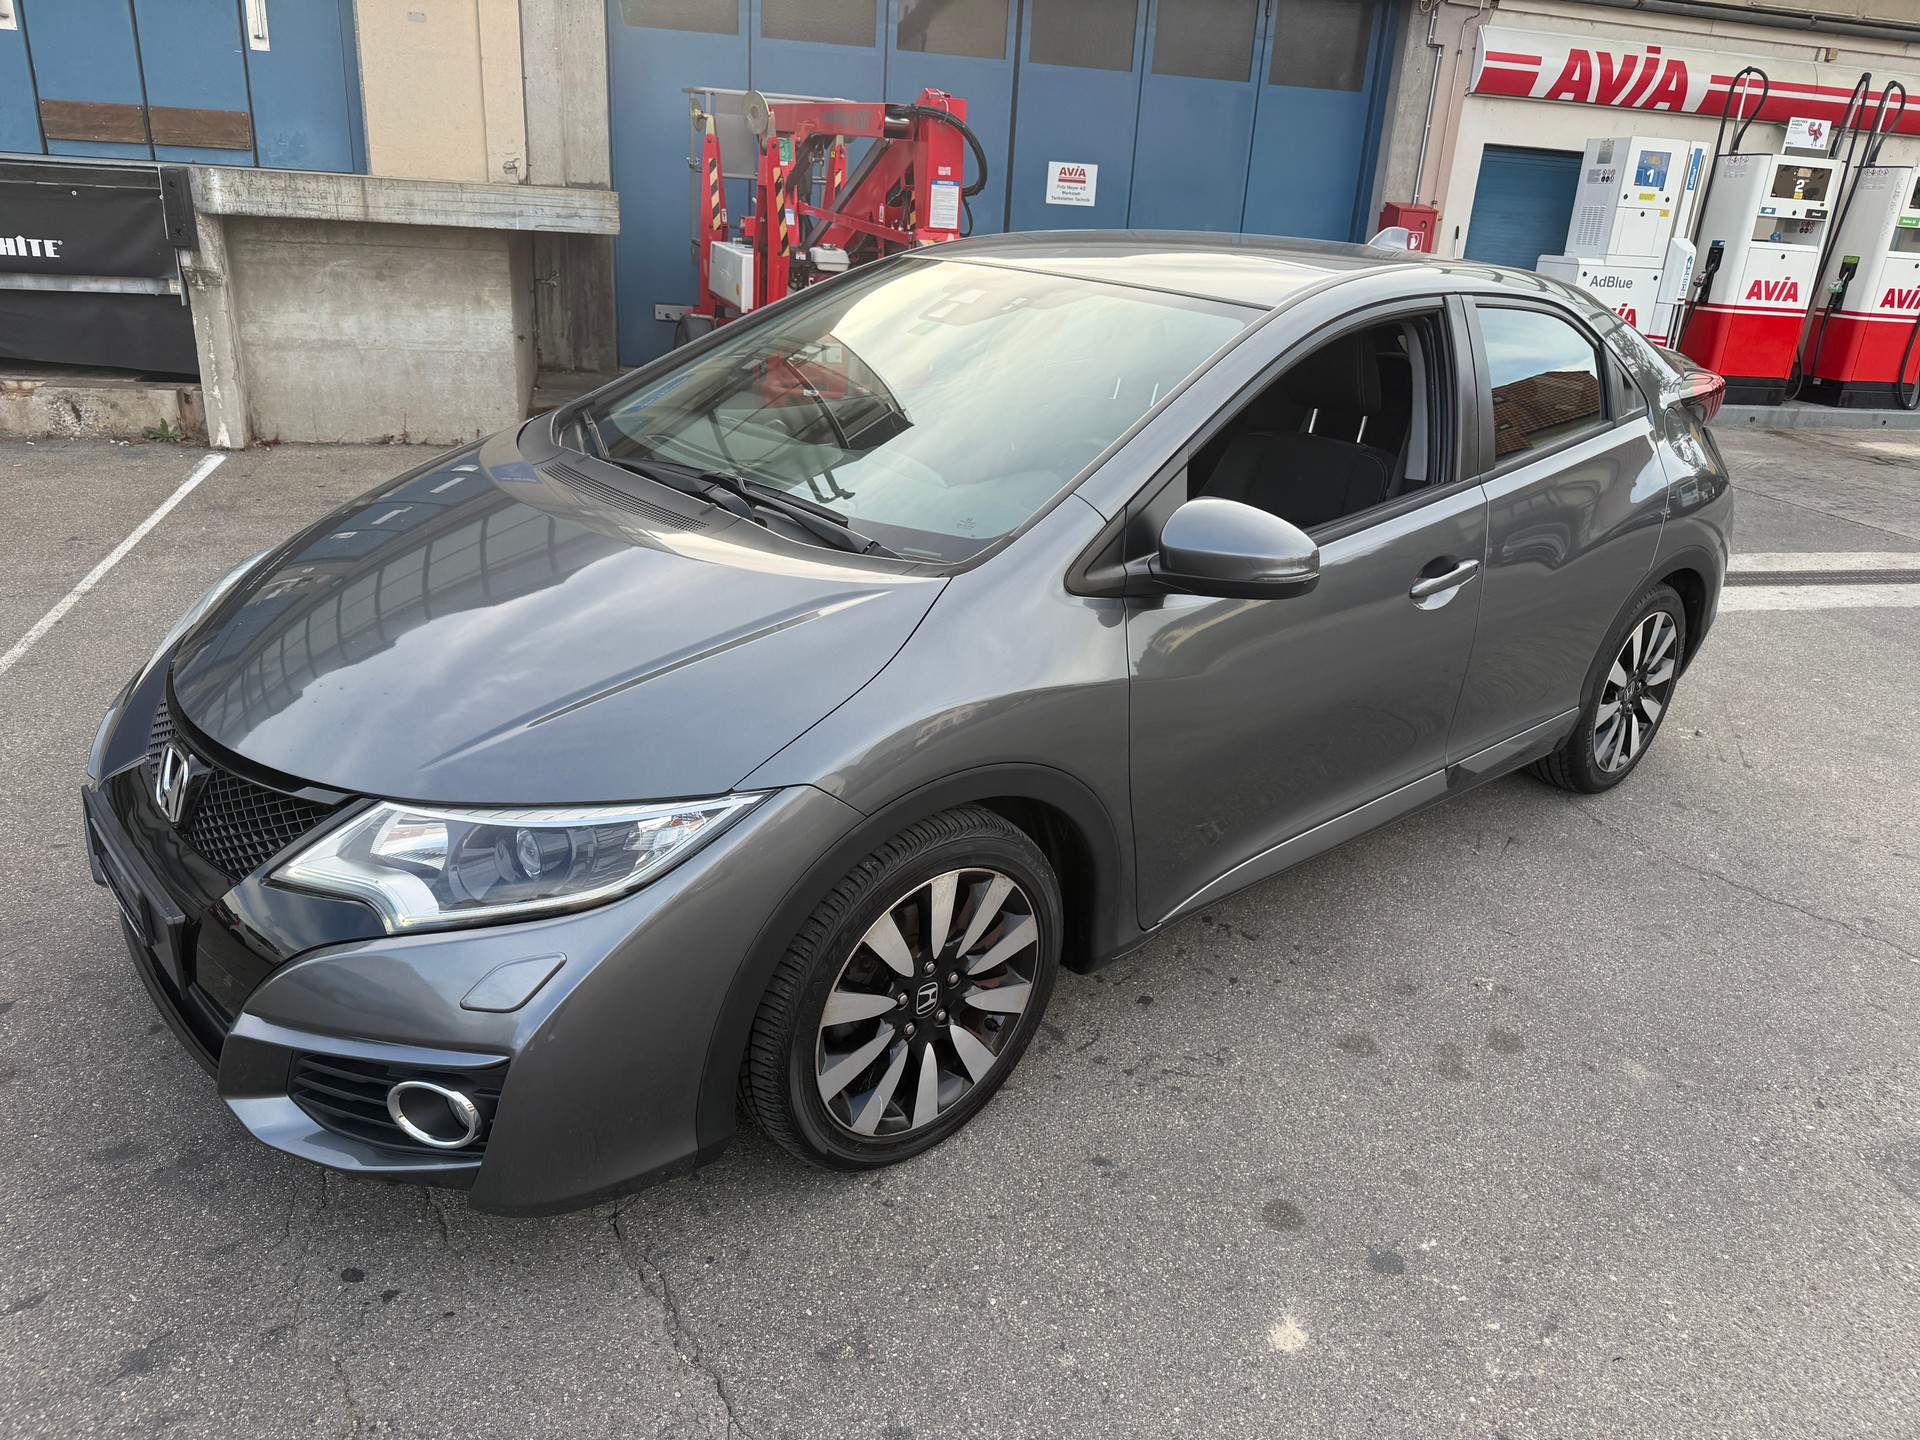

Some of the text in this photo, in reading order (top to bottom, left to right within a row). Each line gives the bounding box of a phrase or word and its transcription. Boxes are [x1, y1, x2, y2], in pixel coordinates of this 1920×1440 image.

[1646, 169, 1655, 183] 1
[1794, 179, 1805, 192] 2
[1589, 275, 1633, 289] AdBlue
